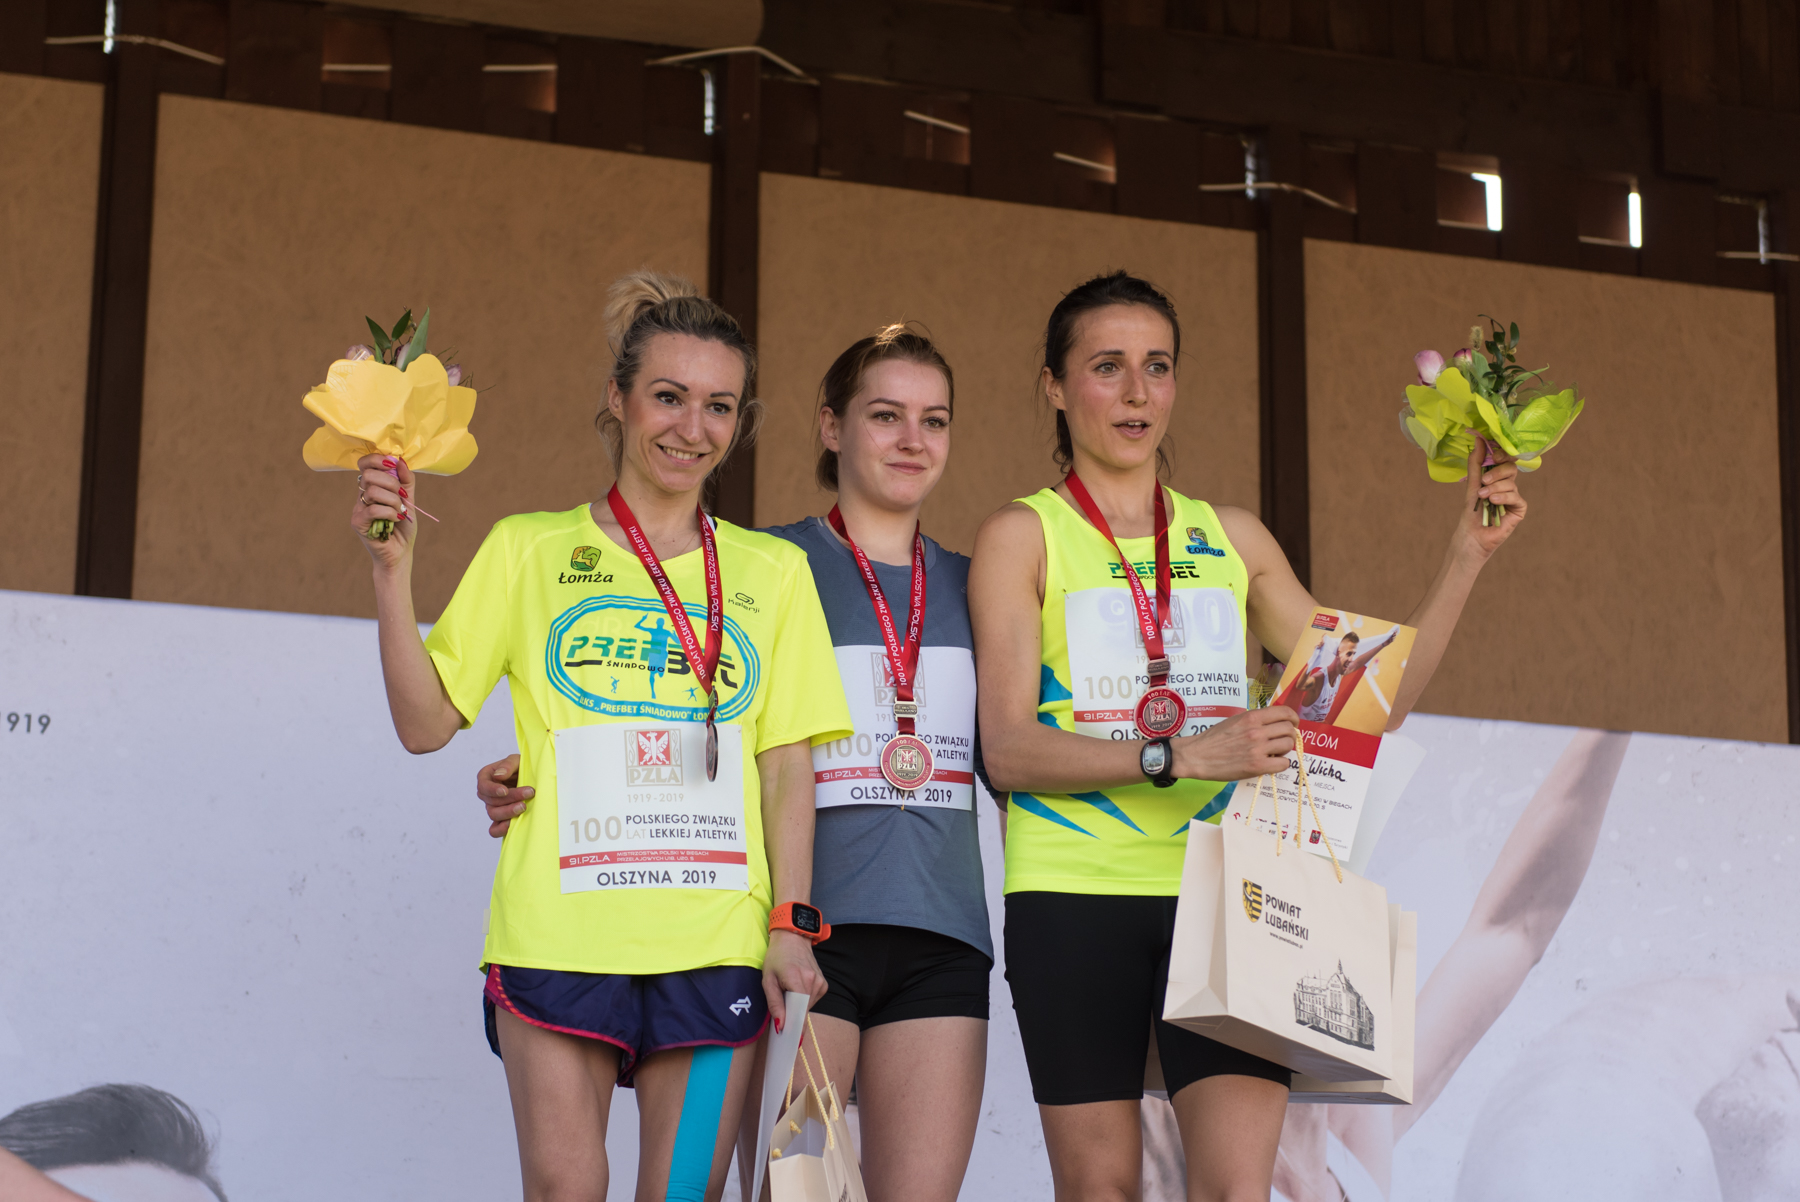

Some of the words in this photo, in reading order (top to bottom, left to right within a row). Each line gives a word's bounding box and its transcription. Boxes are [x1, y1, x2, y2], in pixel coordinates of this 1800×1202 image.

[628, 525, 648, 554] ATLETYKI
[644, 552, 663, 580] LEKKIEJ
[704, 537, 719, 599] MISTRZOSTWA
[859, 558, 876, 584] LEKKIEJ
[558, 571, 614, 584] Łomża
[656, 577, 679, 608] ZWIĄZKU
[870, 582, 889, 615] ZWIĄZKU
[1129, 569, 1147, 612] POLSKIEGO
[710, 599, 719, 632] POLSKI
[908, 607, 921, 642] POLSKI
[1142, 608, 1152, 626] LAT
[672, 608, 695, 650] POLSKIEGO
[884, 615, 902, 657] POLSKIEGO
[1143, 626, 1156, 640] 100
[606, 659, 665, 673] ŚNIADOWO
[690, 646, 702, 665] LAT
[894, 657, 905, 673] LAT
[694, 663, 706, 680] 100
[898, 672, 908, 686] 100
[1196, 672, 1239, 685] ZWIĄZKU
[1083, 675, 1132, 699] 100
[1200, 685, 1241, 697] ATLETYKI
[0, 711, 51, 734] 919
[825, 733, 873, 760] 100
[934, 734, 969, 749] ZWIĄZKU
[1301, 729, 1339, 751] YPLOM
[935, 749, 969, 762] ATLETYKI
[629, 768, 680, 784] PZLA
[1309, 758, 1346, 782] Wicha
[850, 786, 917, 801] OLSZYNA
[924, 788, 953, 803] 2019
[1313, 781, 1335, 791] MIEJSCA
[569, 816, 622, 844] 100
[625, 814, 690, 825] POLSKIEGO
[692, 814, 736, 828] ZWIĄZKU
[626, 828, 647, 840] LAT
[649, 828, 691, 839] LEKKIEJ
[694, 828, 737, 841] ATLETYKI
[597, 870, 673, 887] OLSZYNA
[681, 869, 717, 885] 2019
[1265, 894, 1302, 919] POWIAT
[1265, 911, 1309, 941] LUBAŃSKI
